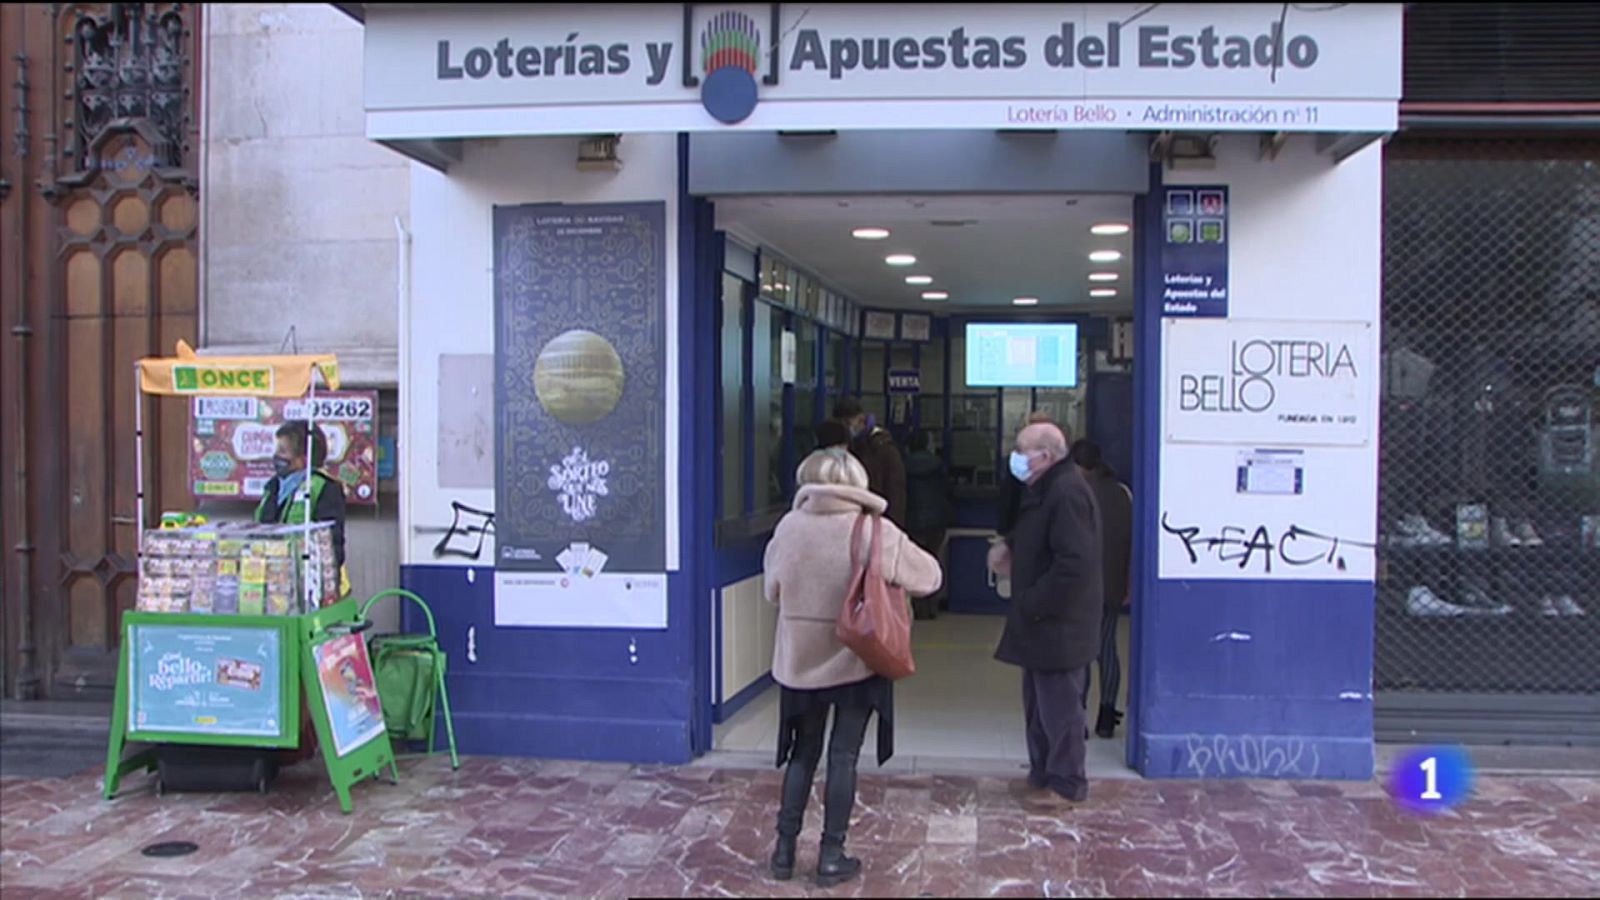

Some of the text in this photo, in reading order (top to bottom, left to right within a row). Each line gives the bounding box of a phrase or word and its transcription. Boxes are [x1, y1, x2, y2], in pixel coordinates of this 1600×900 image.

[437, 22, 1319, 85] Loterías y Apuestas del Estado
[1007, 103, 1068, 123] Lotería
[1074, 104, 1116, 123] Bello
[1143, 104, 1278, 124] Administración
[1305, 105, 1319, 124] 11
[1205, 276, 1212, 287] y
[1164, 287, 1226, 300] Apuestas del
[1164, 302, 1198, 312] Estado
[1232, 340, 1357, 377] LOTERIA
[202, 369, 266, 388] ONCE
[1180, 374, 1275, 412] BELLO
